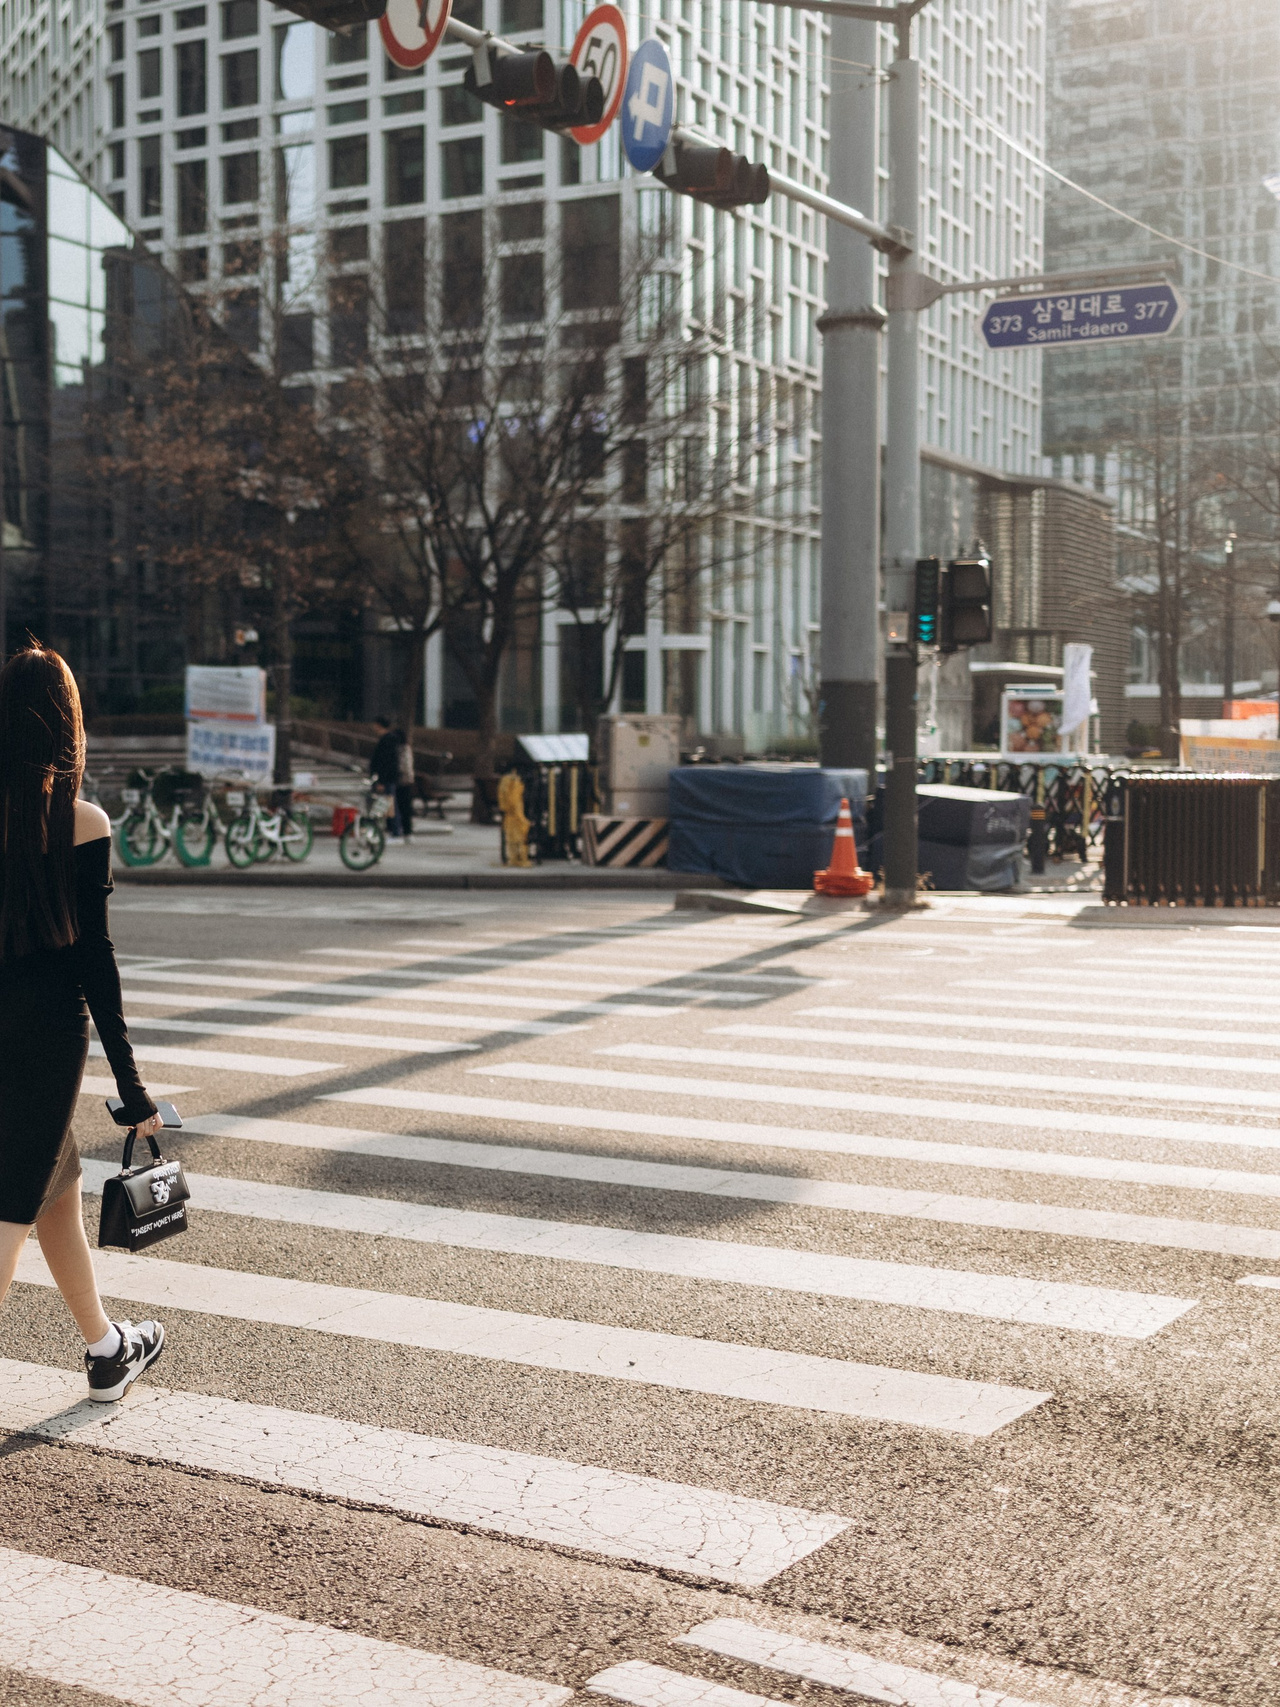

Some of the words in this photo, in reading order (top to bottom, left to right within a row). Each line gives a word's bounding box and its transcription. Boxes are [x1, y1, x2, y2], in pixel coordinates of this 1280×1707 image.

[1032, 294, 1125, 323] 삼일대로
[1134, 300, 1169, 321] 377
[989, 314, 1023, 335] 373
[1027, 321, 1128, 342] Samil-daero
[153, 1214, 171, 1228] MONEY
